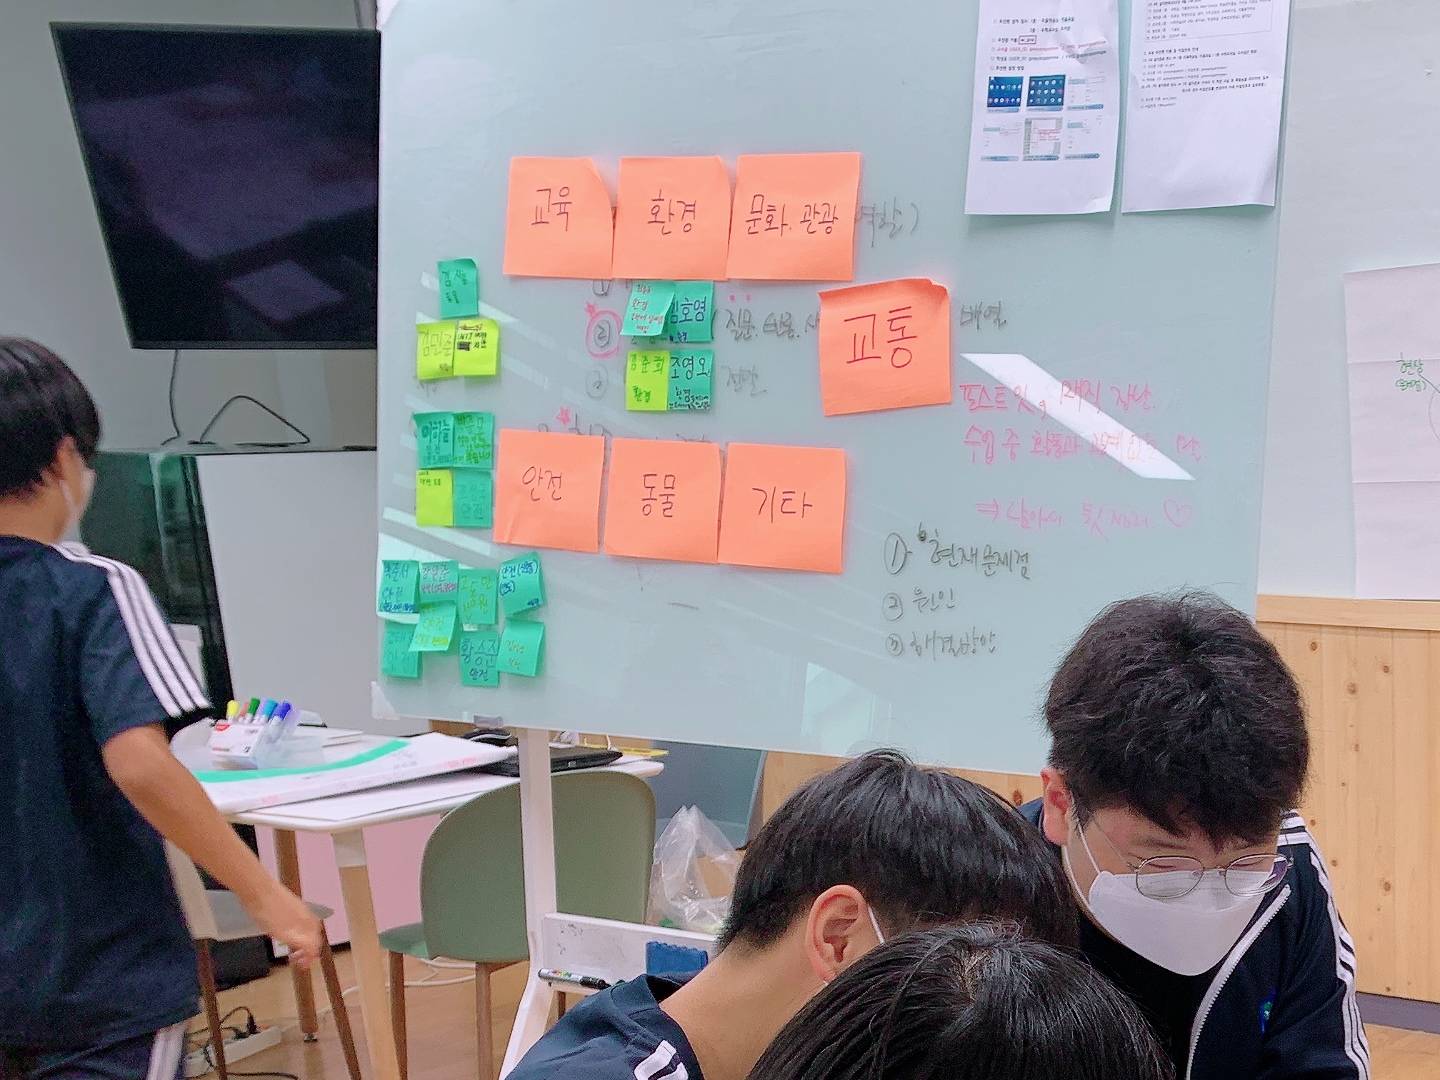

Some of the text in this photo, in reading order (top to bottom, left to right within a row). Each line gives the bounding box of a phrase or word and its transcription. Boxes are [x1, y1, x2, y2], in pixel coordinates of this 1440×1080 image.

[531, 186, 572, 232] 교육
[648, 189, 696, 236] 환경
[844, 306, 918, 369] 교통
[1002, 428, 1021, 460] 중
[521, 465, 563, 502] 안전
[641, 473, 676, 518] 동물
[752, 486, 813, 524] 기타
